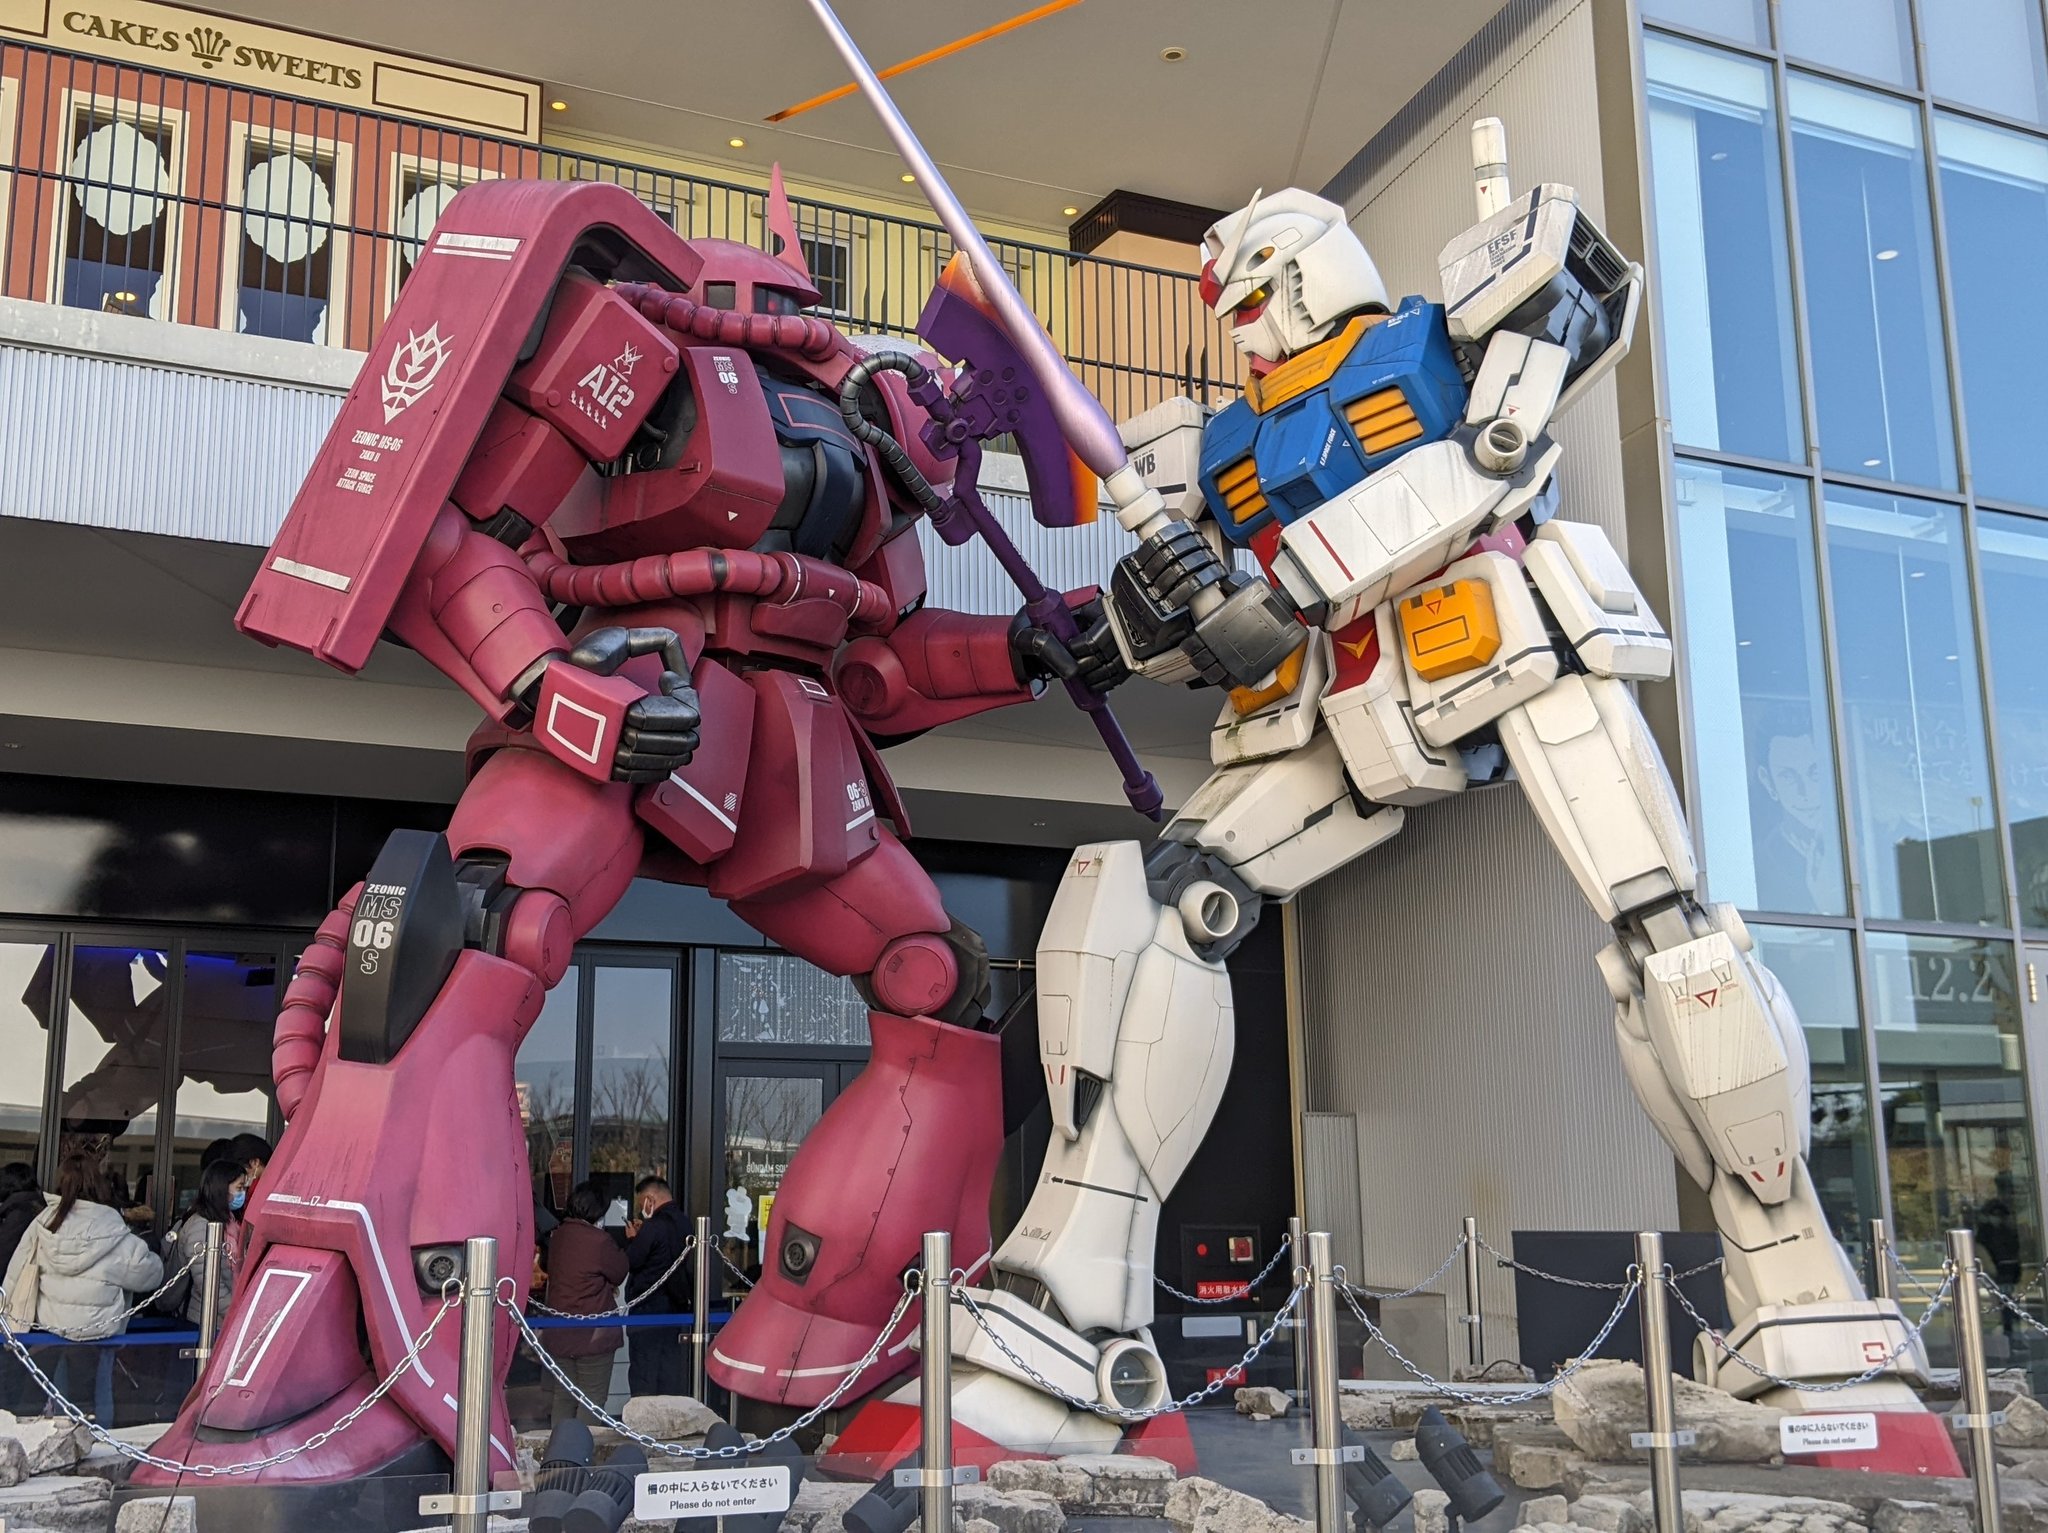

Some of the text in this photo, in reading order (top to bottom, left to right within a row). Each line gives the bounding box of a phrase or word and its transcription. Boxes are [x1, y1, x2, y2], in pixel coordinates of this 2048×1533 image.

[63, 11, 362, 90] CAKES SWEETS
[1487, 229, 1517, 254] EFSF
[718, 371, 739, 384] 06
[577, 363, 636, 420] A12
[351, 429, 404, 452] ZEONIC MS-06
[357, 470, 377, 484] SPACE
[1133, 453, 1156, 478] WB
[335, 477, 358, 492] ATTACK
[366, 883, 407, 896] ZEONIC
[358, 894, 402, 920] MS
[352, 919, 395, 950] 06
[360, 948, 380, 975] S
[1802, 1437, 1822, 1446] Please
[1822, 1437, 1830, 1445] do
[647, 1477, 778, 1496] 柵の中に入らないでください
[669, 1497, 757, 1511] Please do not enter
